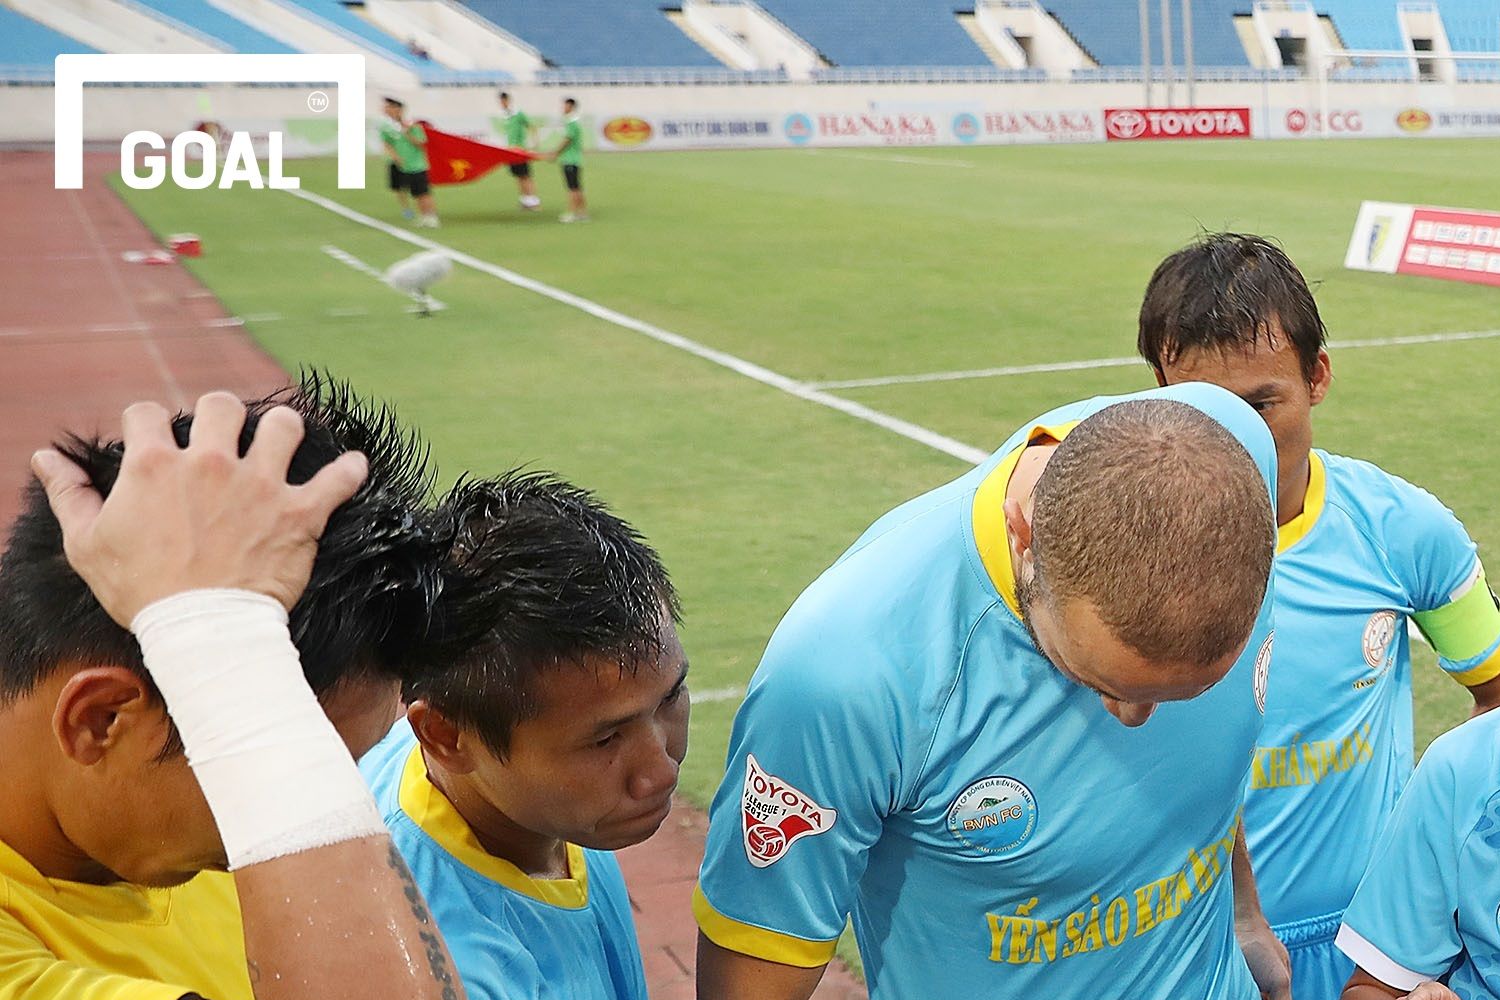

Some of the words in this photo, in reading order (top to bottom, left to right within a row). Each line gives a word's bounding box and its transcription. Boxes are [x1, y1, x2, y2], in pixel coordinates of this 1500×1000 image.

[818, 113, 937, 136] HANAKA
[985, 112, 1096, 134] HANAKA
[1150, 112, 1247, 135] TOYOTA
[748, 763, 821, 829] TOYOTA
[744, 802, 770, 822] 2017
[963, 813, 999, 831] BVN
[1000, 804, 1023, 823] FC
[985, 896, 1061, 965] YẾN
[1062, 894, 1130, 959] SÀO
